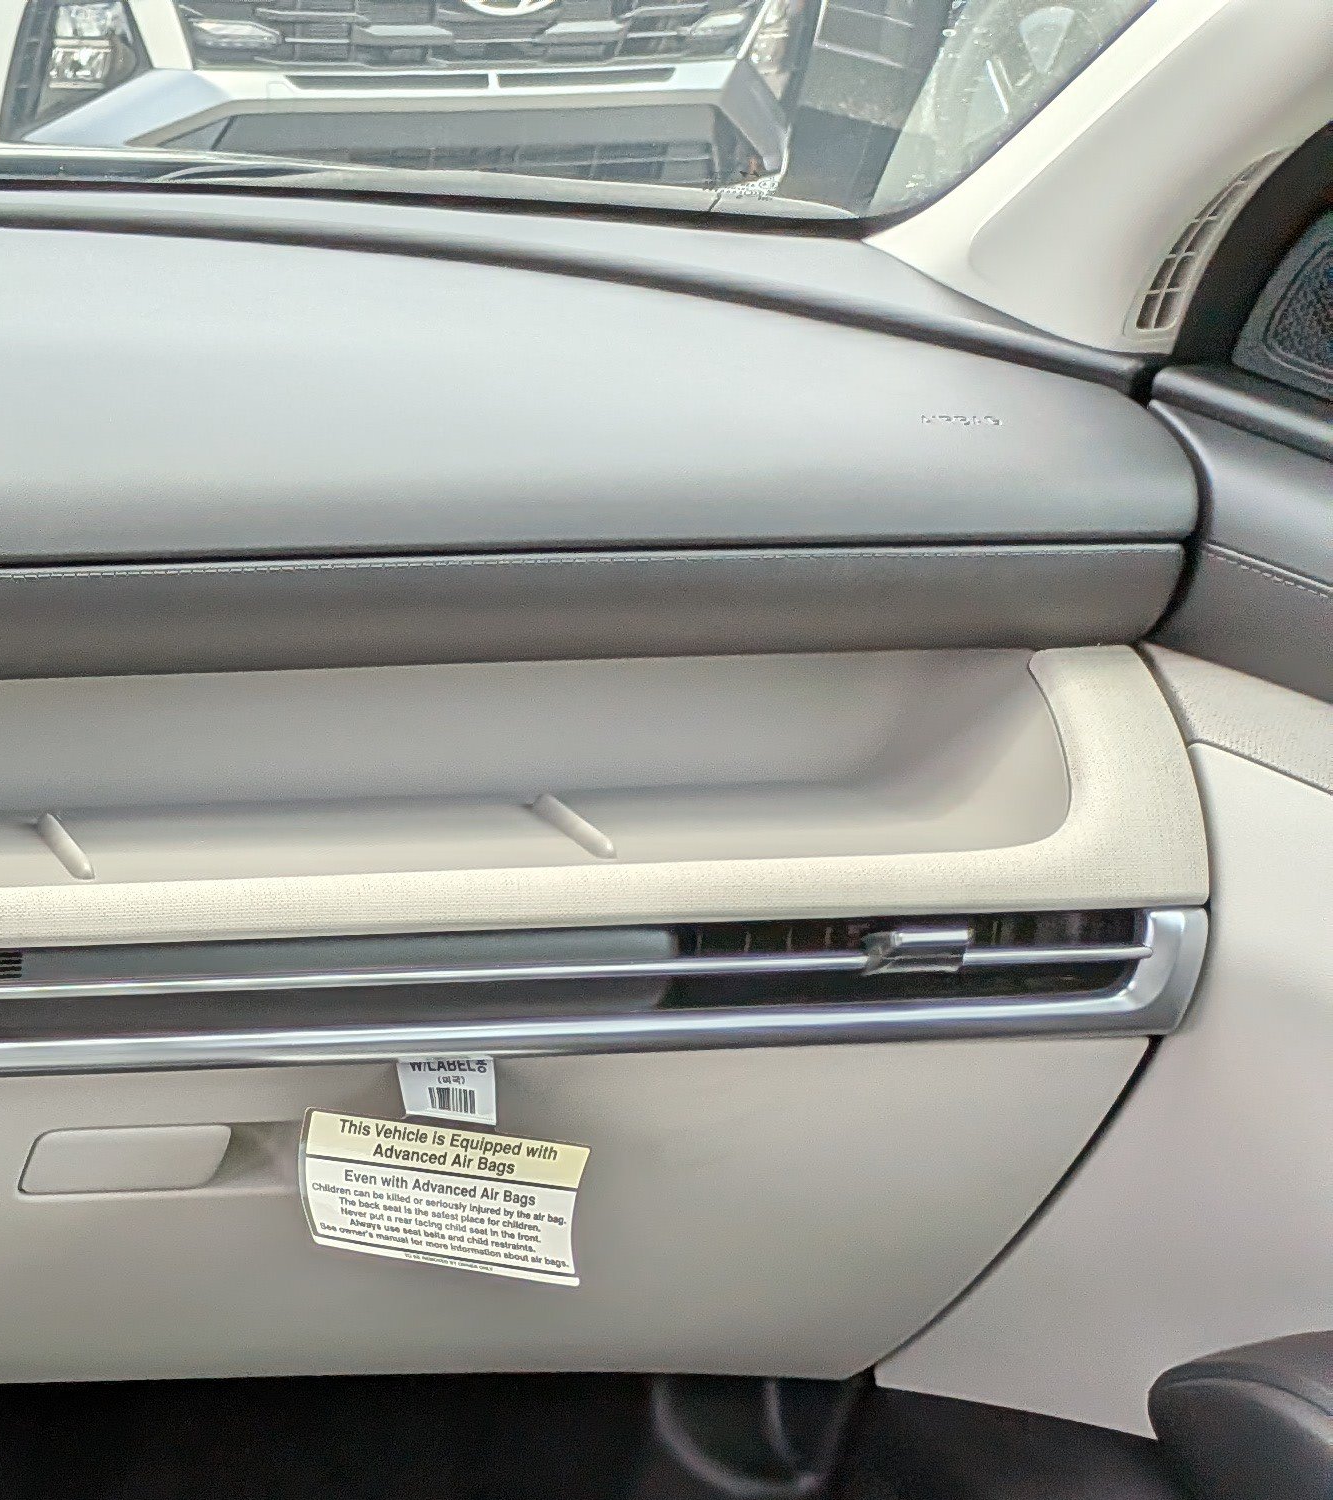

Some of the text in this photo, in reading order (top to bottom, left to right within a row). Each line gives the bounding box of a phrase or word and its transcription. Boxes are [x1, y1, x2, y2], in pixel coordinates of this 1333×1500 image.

[339, 1118, 558, 1161] This Vehicle is Equipped with
[373, 1143, 516, 1176] Advanced Air Bags
[312, 1182, 351, 1196] Children
[353, 1190, 370, 1199] can
[386, 1193, 411, 1204] killed
[413, 1197, 423, 1205] or
[425, 1199, 467, 1212] seriously
[469, 1203, 501, 1216] injured
[503, 1207, 514, 1219] by
[517, 1209, 531, 1220] the
[533, 1212, 545, 1222] air
[547, 1213, 567, 1226] bag.
[344, 1168, 536, 1207] Even with Advanced Air Bags
[339, 1196, 357, 1207] The
[359, 1199, 381, 1210] back
[383, 1203, 401, 1213] seat
[415, 1207, 428, 1217] the
[432, 1209, 458, 1222] safest
[461, 1213, 485, 1225] place
[487, 1216, 500, 1227] for
[502, 1219, 541, 1233] children.
[395, 1216, 412, 1225] rear
[445, 1222, 467, 1233] child
[469, 1226, 488, 1236] seat
[490, 1227, 499, 1237] in
[501, 1229, 515, 1240] the
[403, 1226, 421, 1236] seat
[448, 1232, 464, 1242] and
[467, 1236, 488, 1247] child
